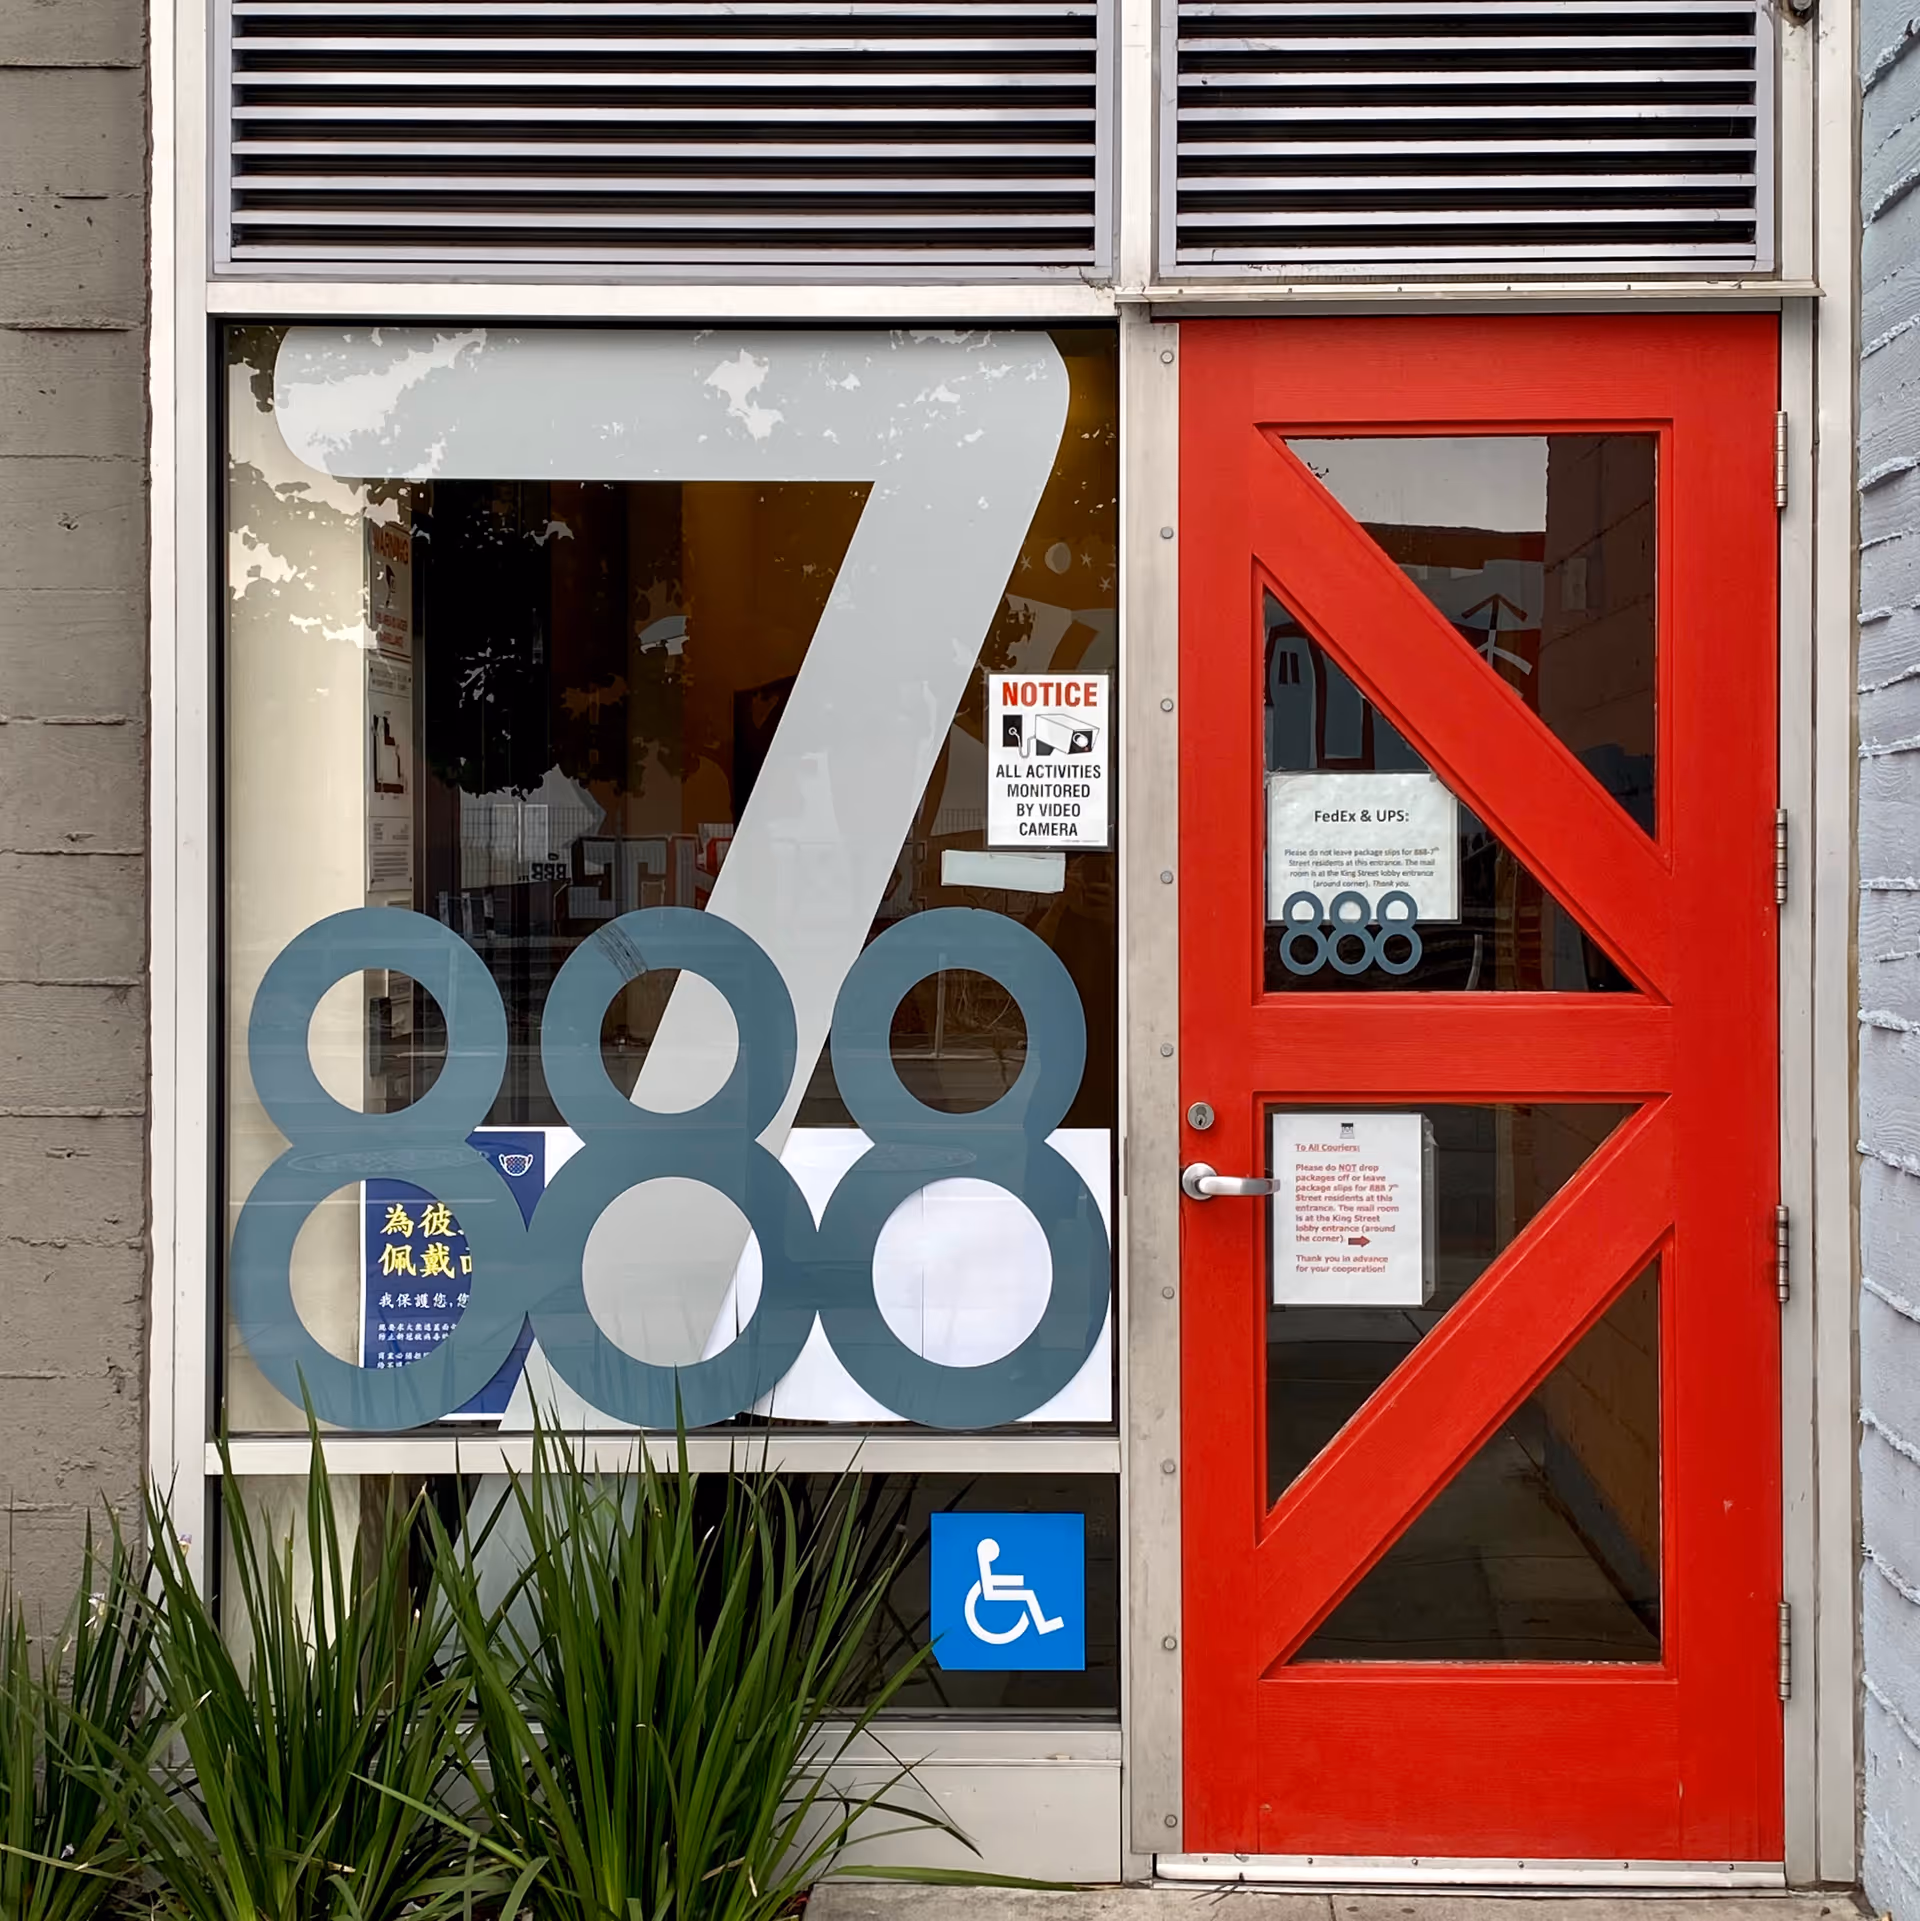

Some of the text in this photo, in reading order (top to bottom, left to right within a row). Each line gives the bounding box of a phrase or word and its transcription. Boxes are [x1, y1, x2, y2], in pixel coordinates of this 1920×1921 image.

[1003, 682, 1097, 707] NOTICE
[996, 765, 1101, 778] ALL ACTIVITIES
[1008, 784, 1090, 797] MONITORED
[1017, 804, 1080, 816] BY VIDEO
[1315, 810, 1409, 822] FedEx & UPS:
[1019, 823, 1077, 836] CAMERA
[1385, 849, 1400, 857] slips
[1414, 847, 1439, 856] 888-7th
[1341, 870, 1355, 878] King
[1381, 870, 1400, 878] lobby
[1280, 891, 1423, 975] 888
[274, 328, 1070, 1670] 7
[1296, 1144, 1360, 1152] To All Couriers:
[230, 906, 1111, 1429] 888
[1359, 1164, 1379, 1172] drop
[380, 1203, 464, 1238] 為彼
[1333, 1215, 1351, 1223] King
[1296, 1225, 1318, 1233] lobby
[1362, 1225, 1395, 1233] (around
[1332, 1265, 1385, 1273] cooperation!
